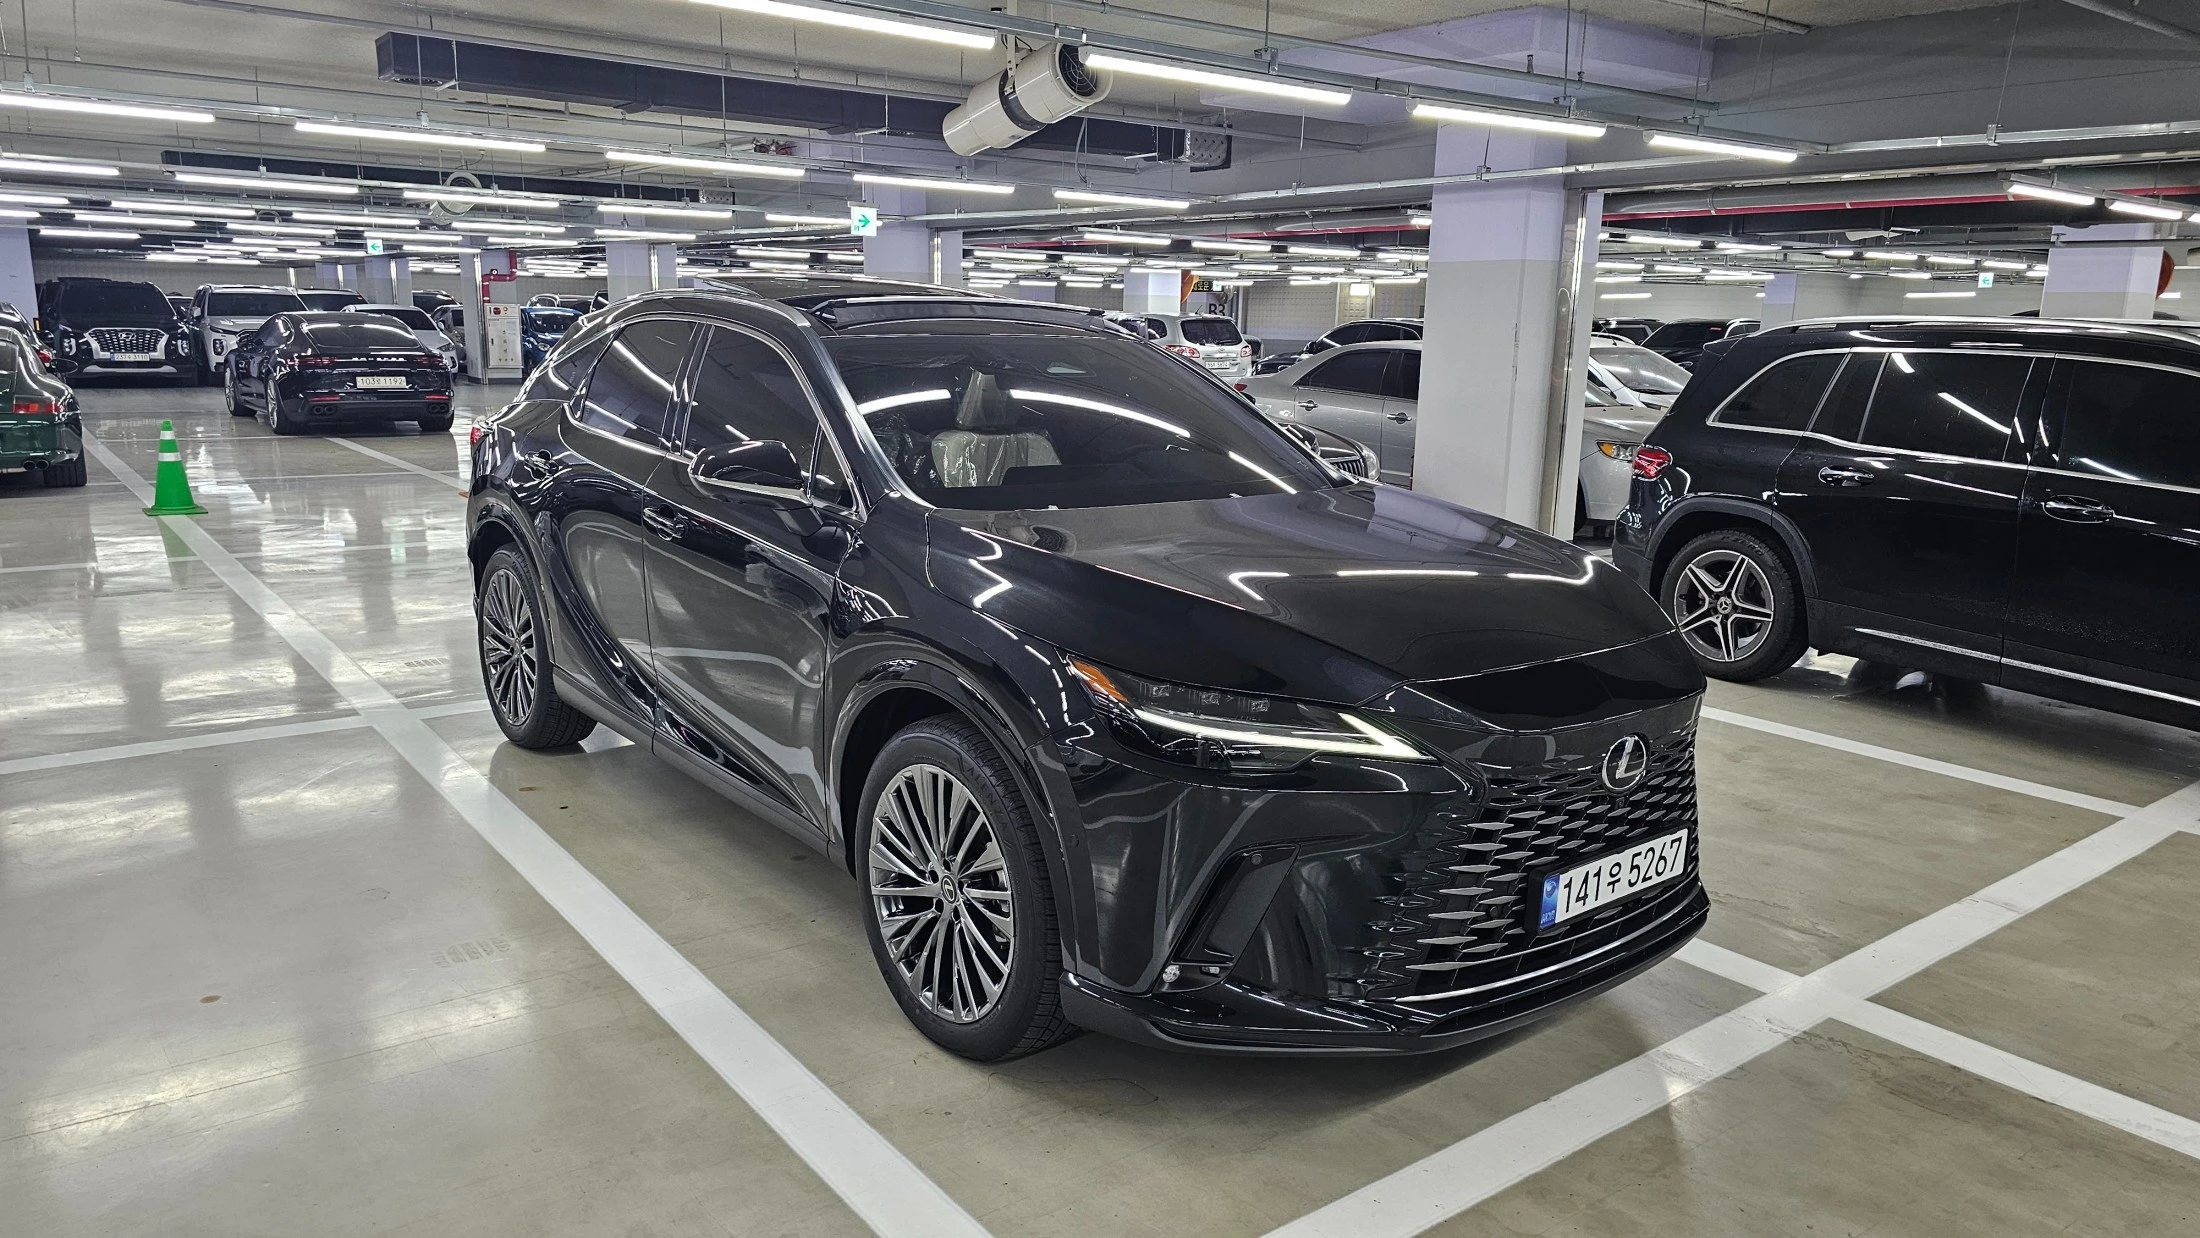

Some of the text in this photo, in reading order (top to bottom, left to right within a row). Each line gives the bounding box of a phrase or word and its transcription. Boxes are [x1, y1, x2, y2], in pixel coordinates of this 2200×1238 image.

[383, 377, 403, 385] 1192
[1563, 836, 1683, 913] 141우 5267
